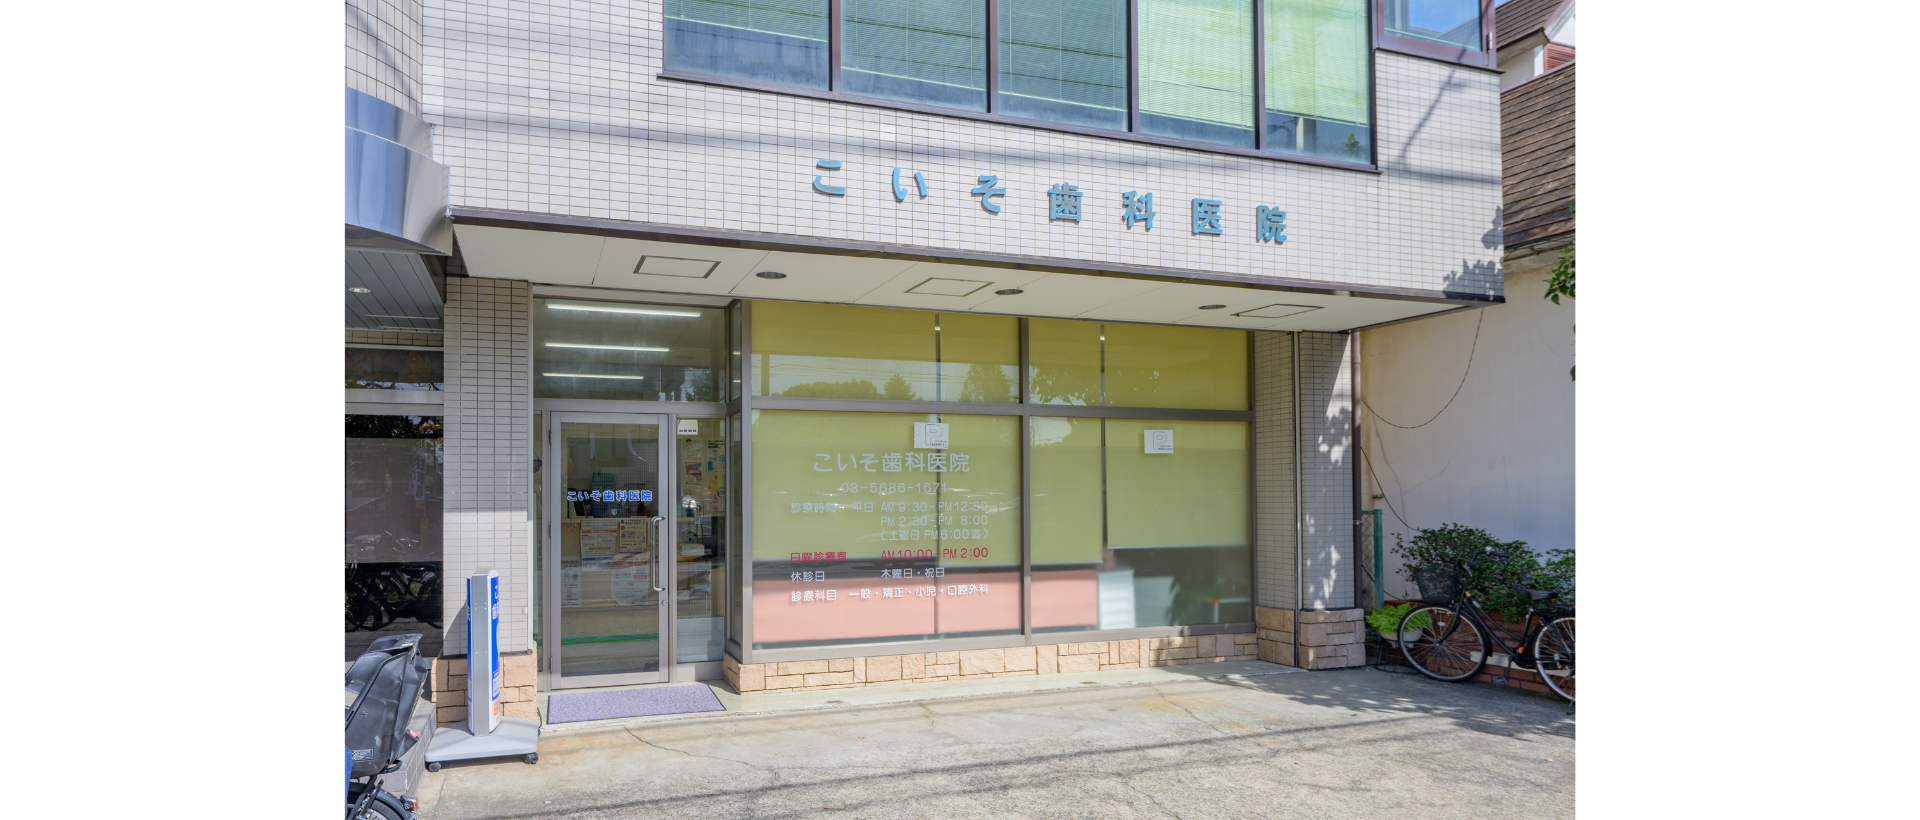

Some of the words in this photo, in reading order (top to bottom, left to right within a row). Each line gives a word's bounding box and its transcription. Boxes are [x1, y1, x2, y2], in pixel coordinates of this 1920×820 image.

[813, 159, 1287, 242] こいそ歯科医院
[813, 452, 970, 472] こいそ歯科医院
[840, 482, 947, 494] 03-5686-1671
[567, 489, 653, 502] こいそ歯科医院
[790, 502, 837, 513] 診療時間
[852, 501, 874, 513] 平日
[790, 551, 847, 564] 日曜診療有
[790, 570, 825, 582] 休診日
[880, 567, 945, 579] 木曜日・祝日
[791, 589, 837, 602] 診療科目
